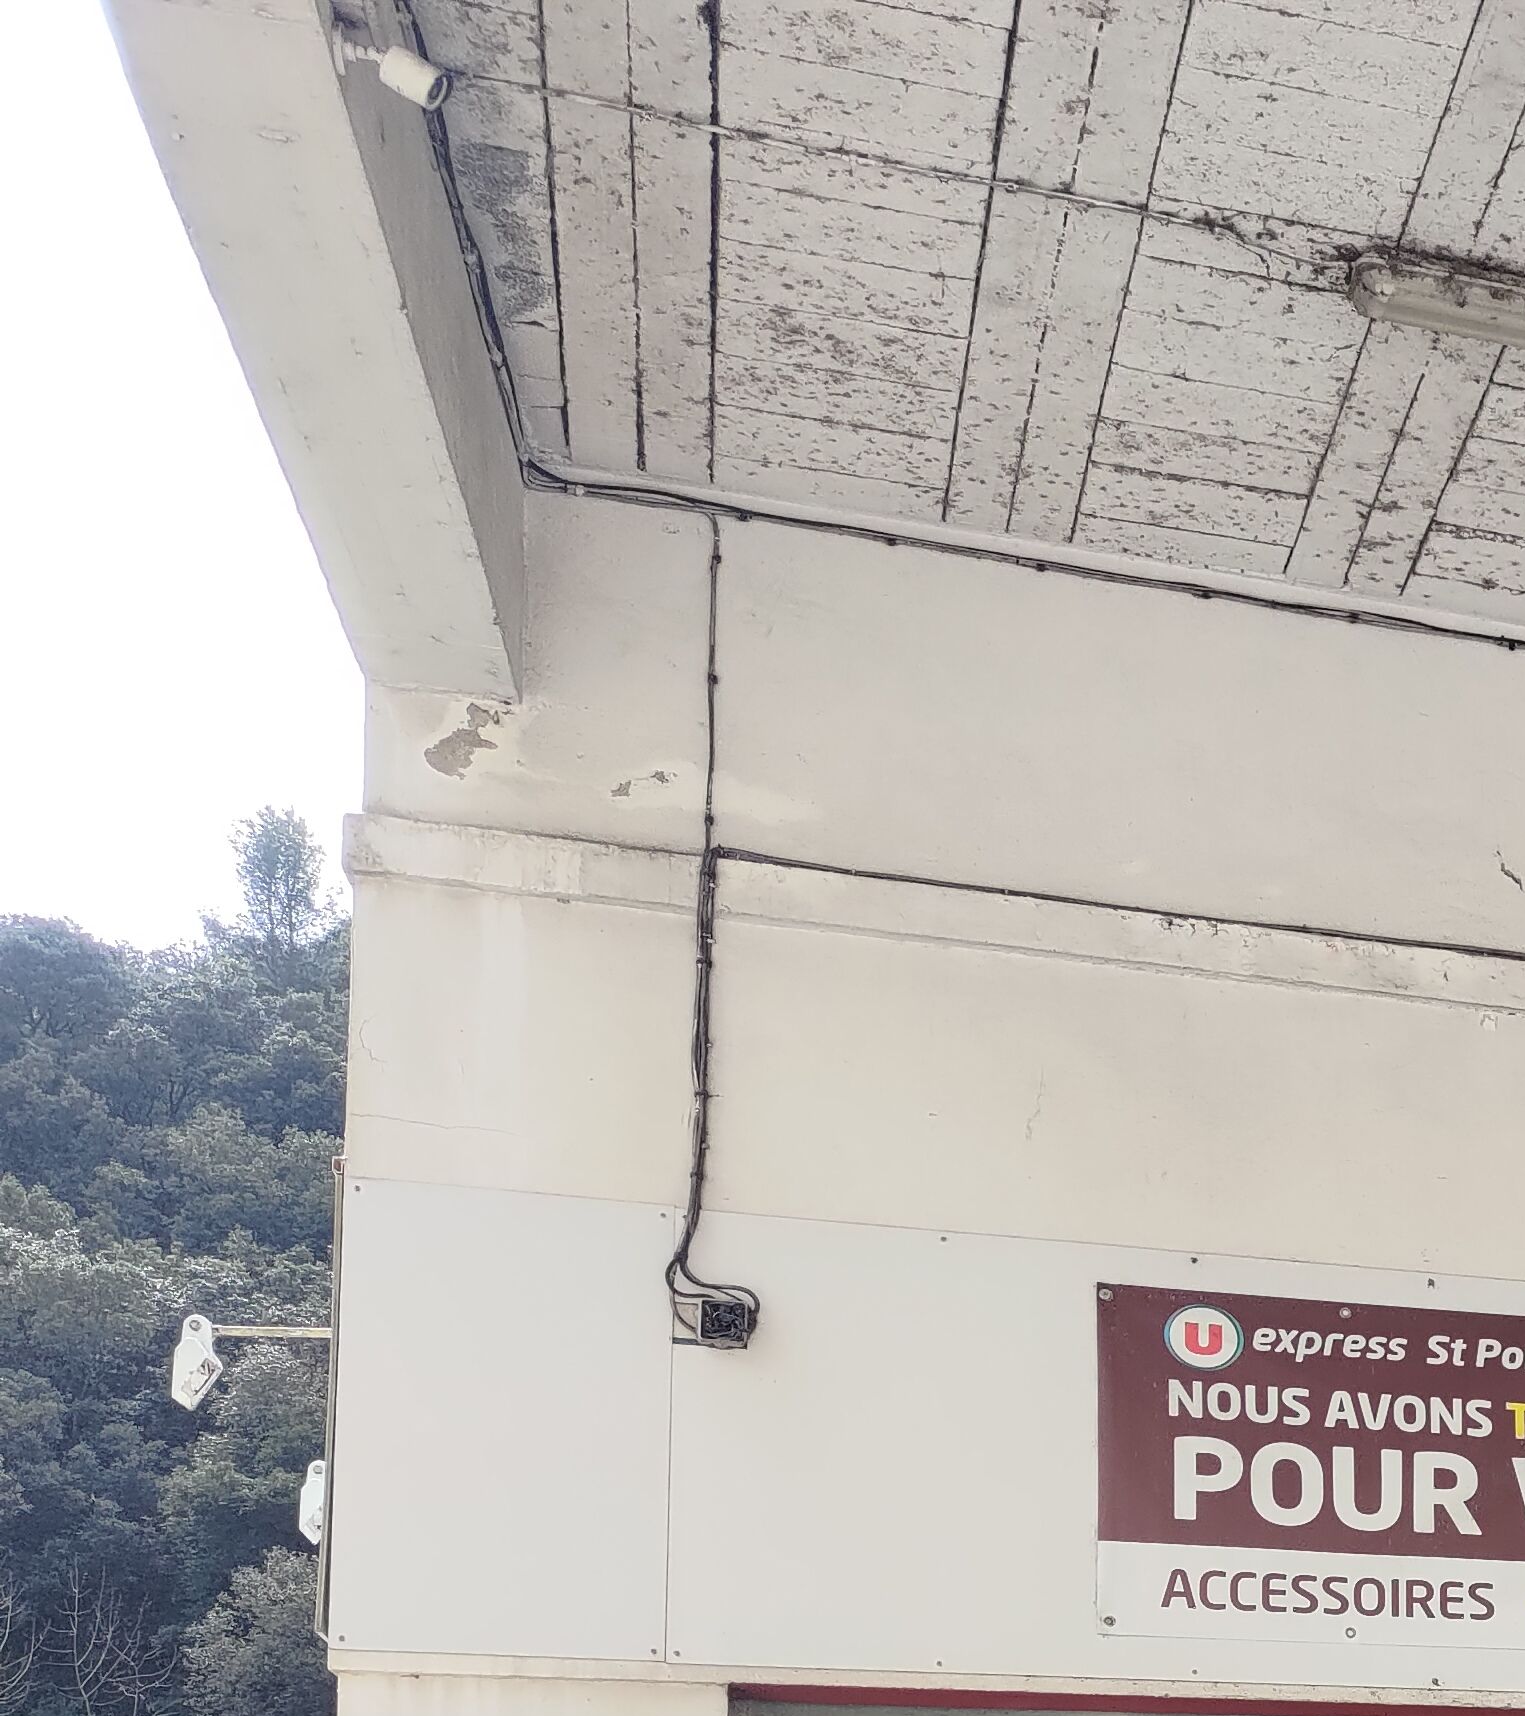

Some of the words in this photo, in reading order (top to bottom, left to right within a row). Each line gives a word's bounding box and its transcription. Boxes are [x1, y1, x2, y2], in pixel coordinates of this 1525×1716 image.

[1184, 1322, 1222, 1355] U
[1253, 1326, 1408, 1363] express
[1427, 1334, 1466, 1368] St
[1167, 1379, 1310, 1426] NOUS
[1324, 1391, 1493, 1438] AVONS
[1172, 1435, 1482, 1537] POUR
[1161, 1568, 1496, 1620] ACCESSOIRES
